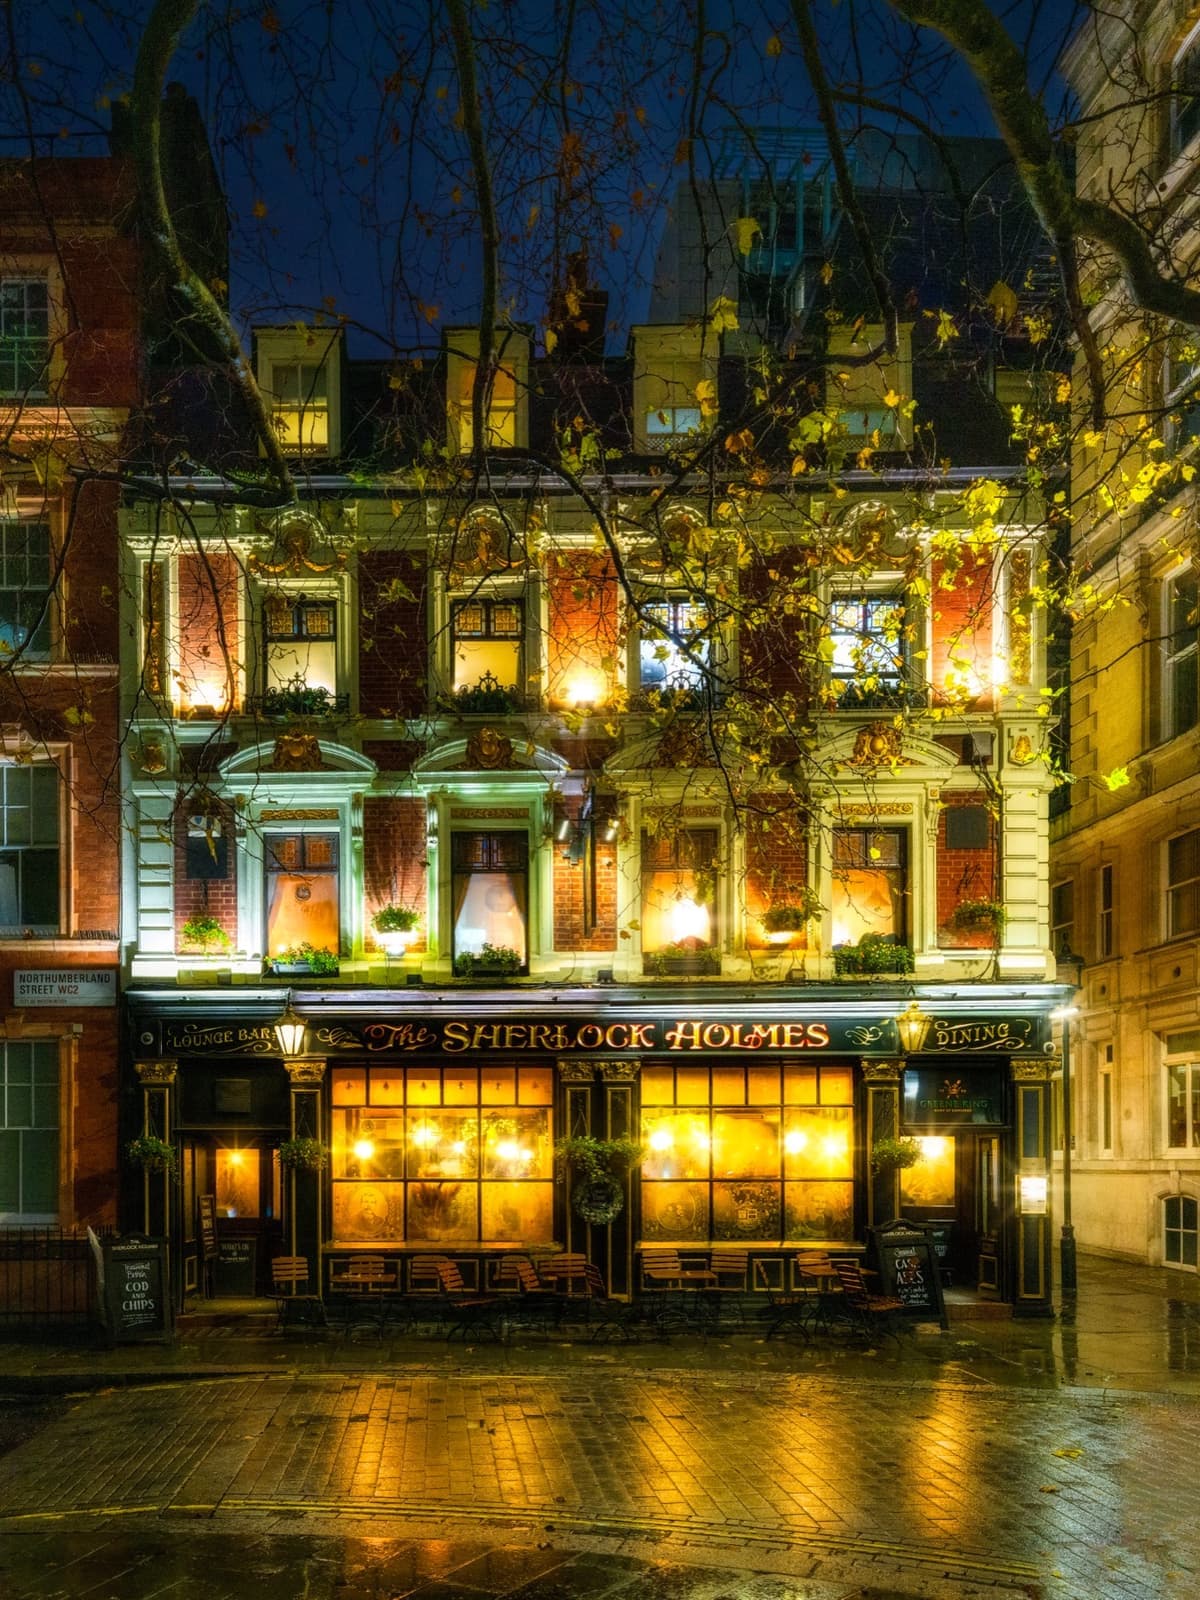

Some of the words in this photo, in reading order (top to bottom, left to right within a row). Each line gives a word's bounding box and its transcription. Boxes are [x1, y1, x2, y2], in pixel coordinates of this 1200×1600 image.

[19, 973, 111, 984] NORTHUMBERLAND
[19, 984, 54, 995] STREET
[58, 984, 79, 995] WC2
[173, 1030, 234, 1048] LOUNGE
[238, 1027, 271, 1041] BAR
[364, 1023, 437, 1050] The
[442, 1022, 656, 1052] SHERLOCK
[665, 1021, 830, 1050] HOLMES
[936, 1022, 1009, 1046] DINING
[125, 1281, 149, 1292] COD
[122, 1299, 155, 1311] CHIPS
